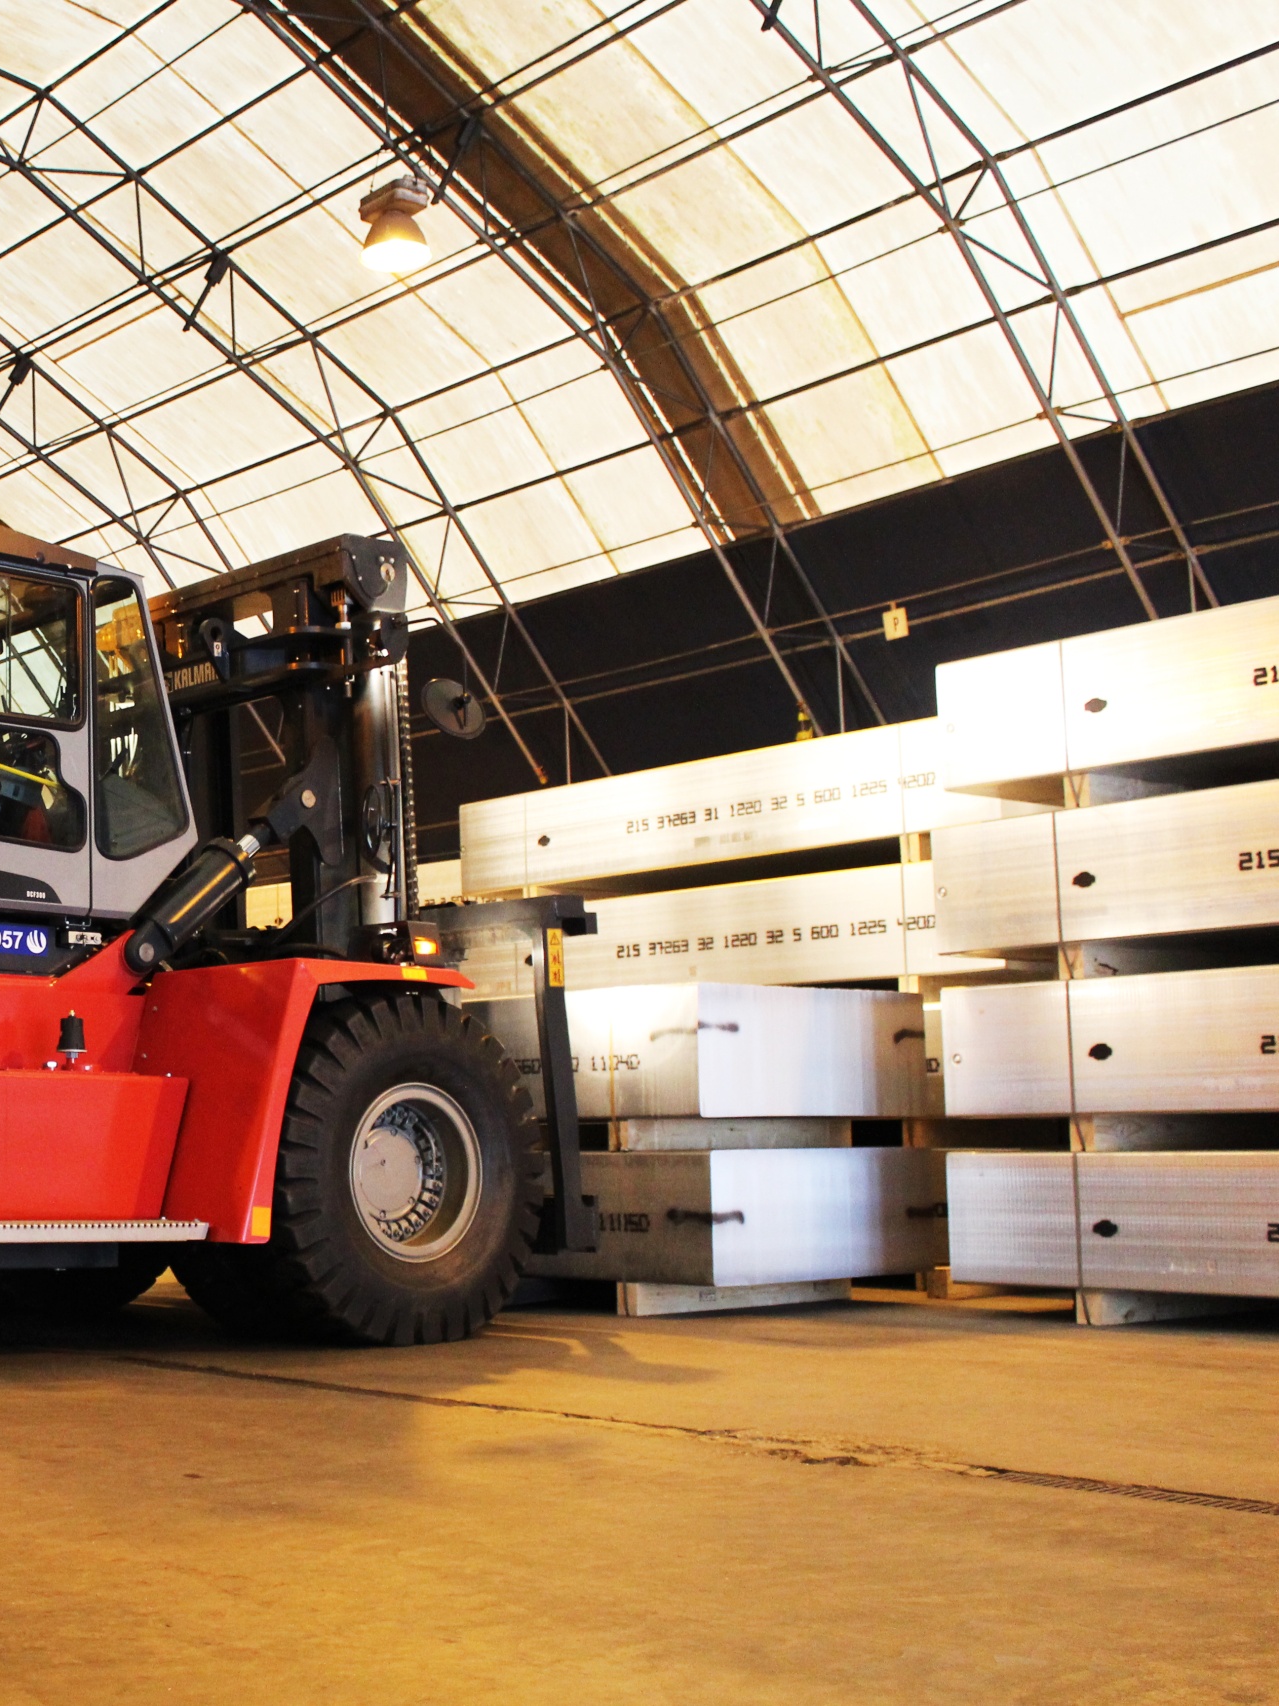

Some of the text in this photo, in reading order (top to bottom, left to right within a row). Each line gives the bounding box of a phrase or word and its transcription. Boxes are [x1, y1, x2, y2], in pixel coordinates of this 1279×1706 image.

[626, 818, 649, 834] 215
[704, 807, 719, 822] 31
[730, 800, 762, 817] 1220
[771, 795, 788, 811] 32
[796, 793, 805, 807] 5
[814, 787, 841, 804] 600
[852, 779, 888, 798] 1225
[1238, 849, 1279, 871] 215
[616, 943, 641, 959] 215
[648, 939, 689, 956] 37263
[697, 936, 714, 951] 32
[724, 932, 757, 949] 1220
[766, 929, 784, 945] 32
[792, 928, 802, 942] 5
[811, 924, 839, 940] 600
[850, 919, 887, 936] 1225
